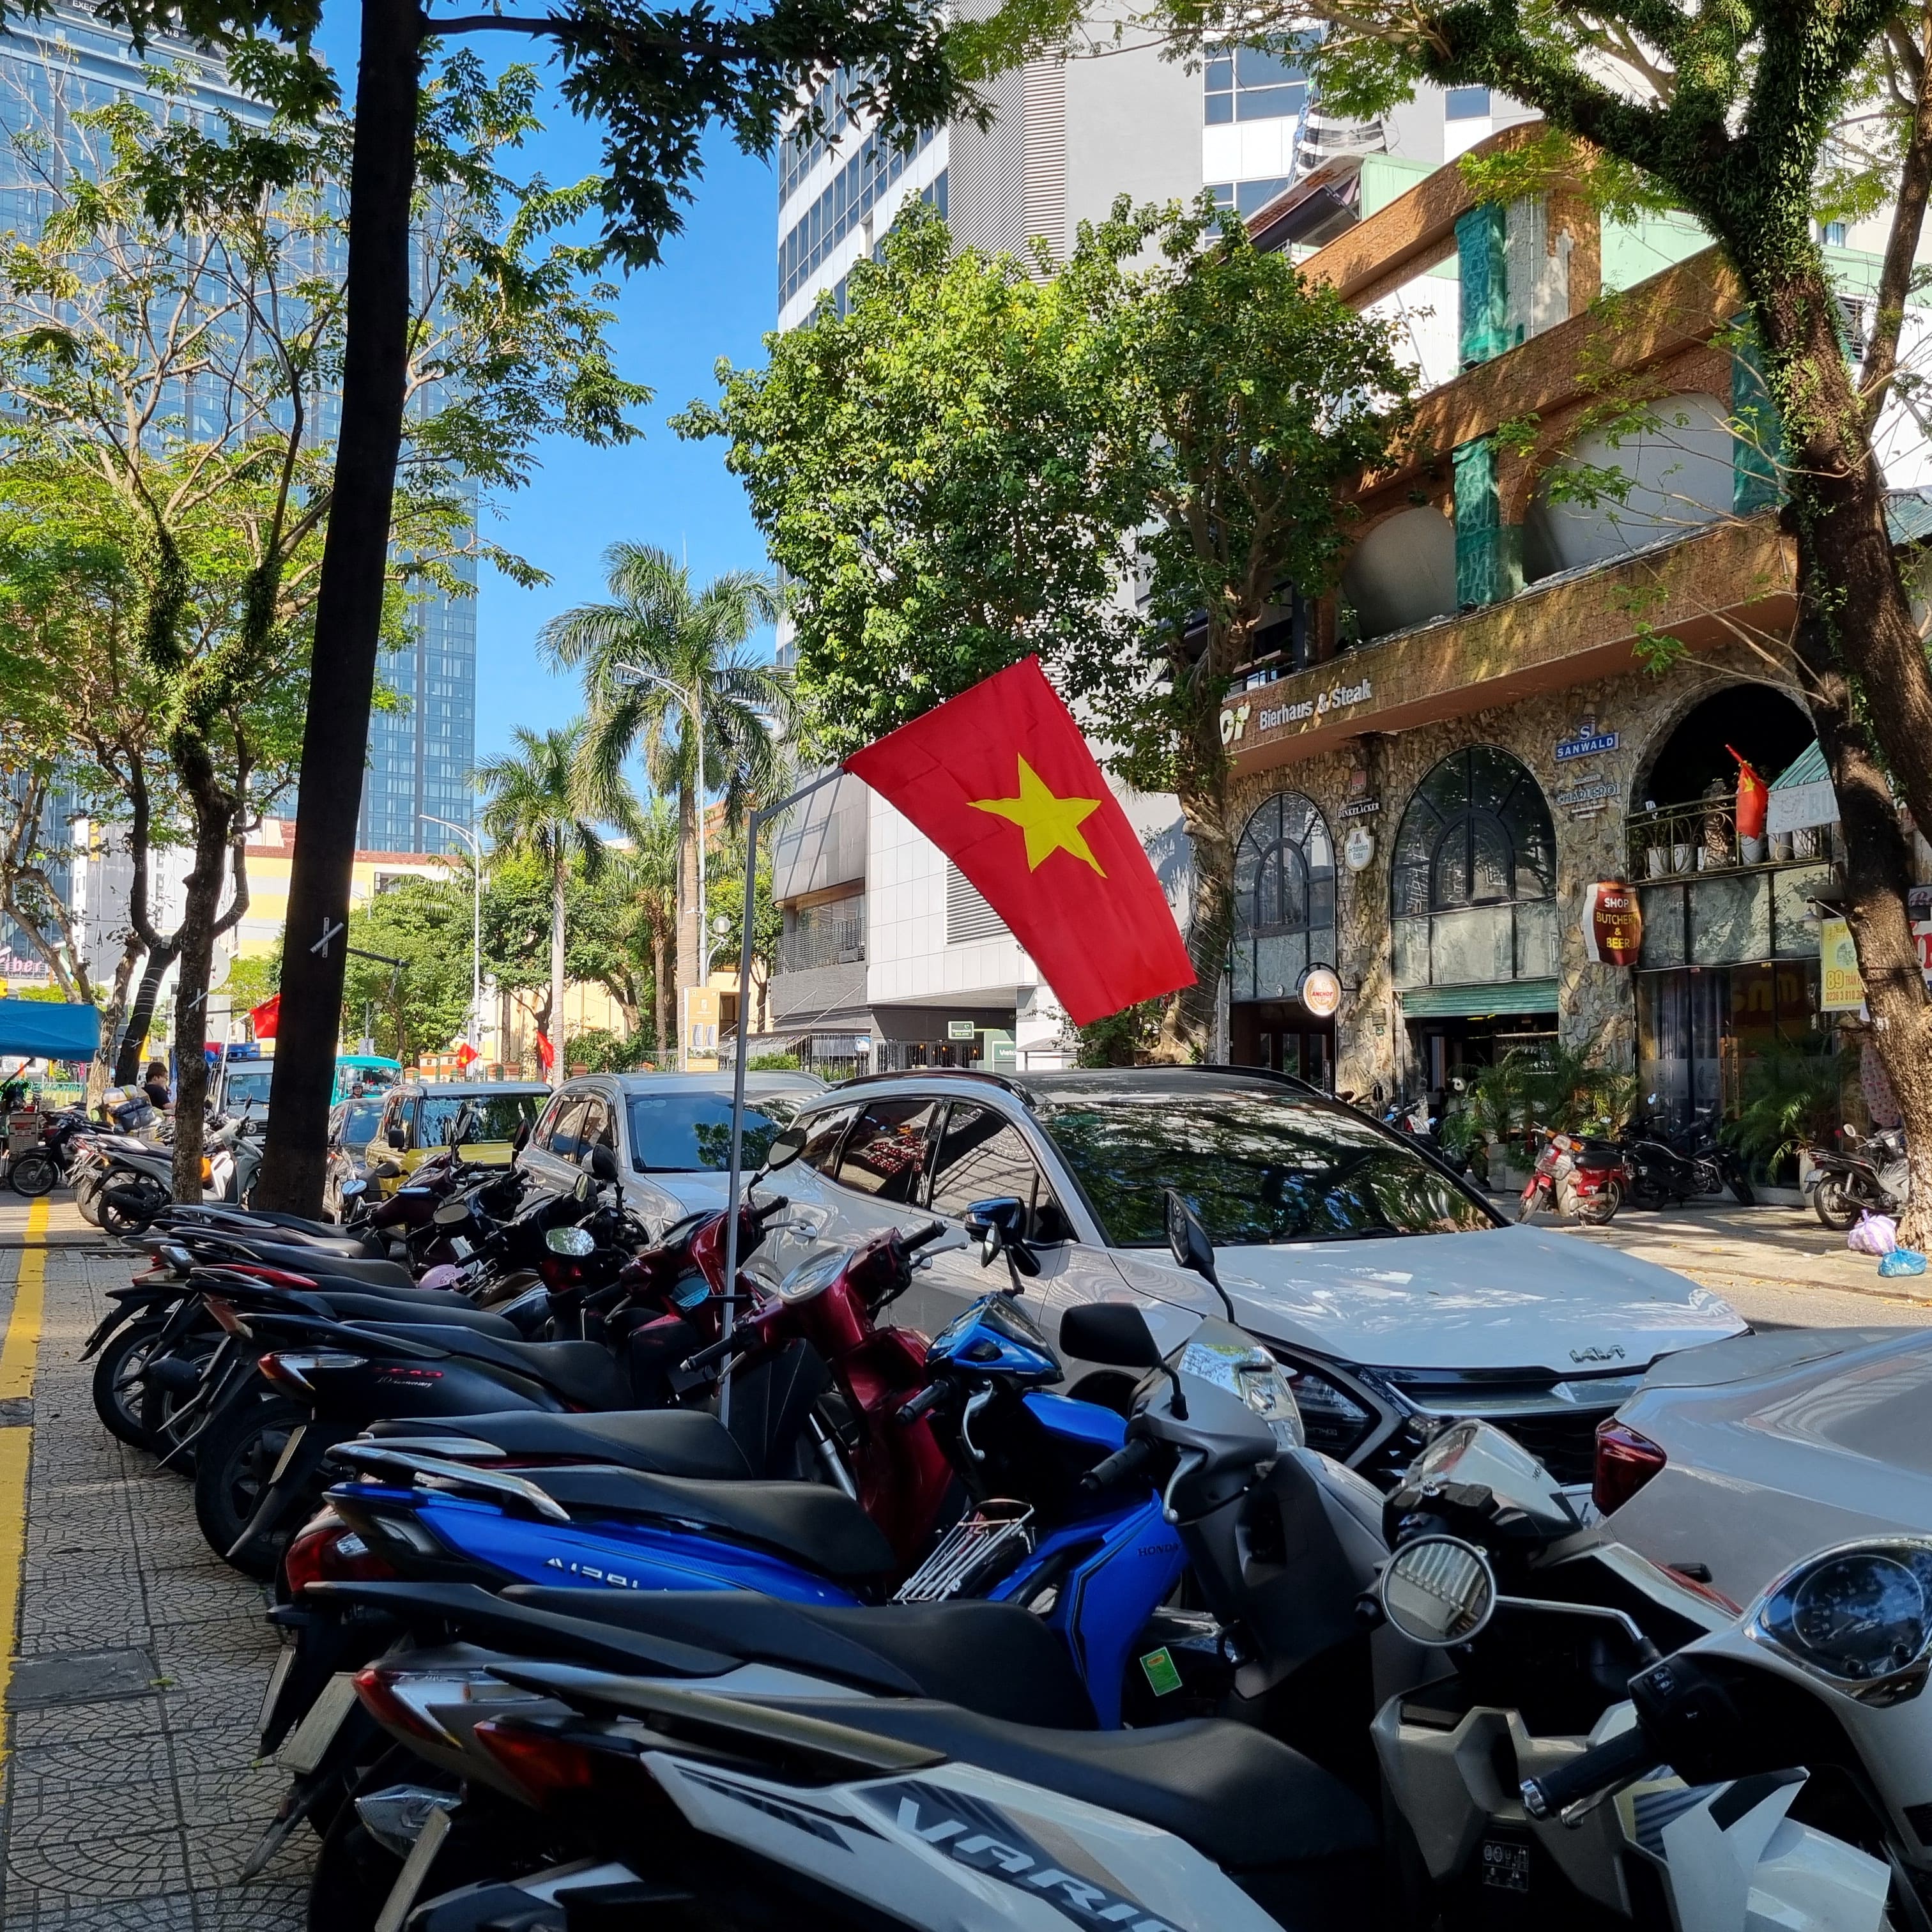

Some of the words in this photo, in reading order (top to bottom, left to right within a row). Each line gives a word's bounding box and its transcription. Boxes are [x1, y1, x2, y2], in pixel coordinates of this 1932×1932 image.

[1259, 700, 1313, 730] Bierhaus
[1317, 693, 1329, 714] &
[1332, 678, 1372, 709] Steak
[1557, 737, 1614, 758] SANWALD
[1604, 897, 1629, 908] SHOP
[1614, 927, 1621, 936] &
[1606, 937, 1630, 949] BEER
[1826, 969, 1844, 990] 89
